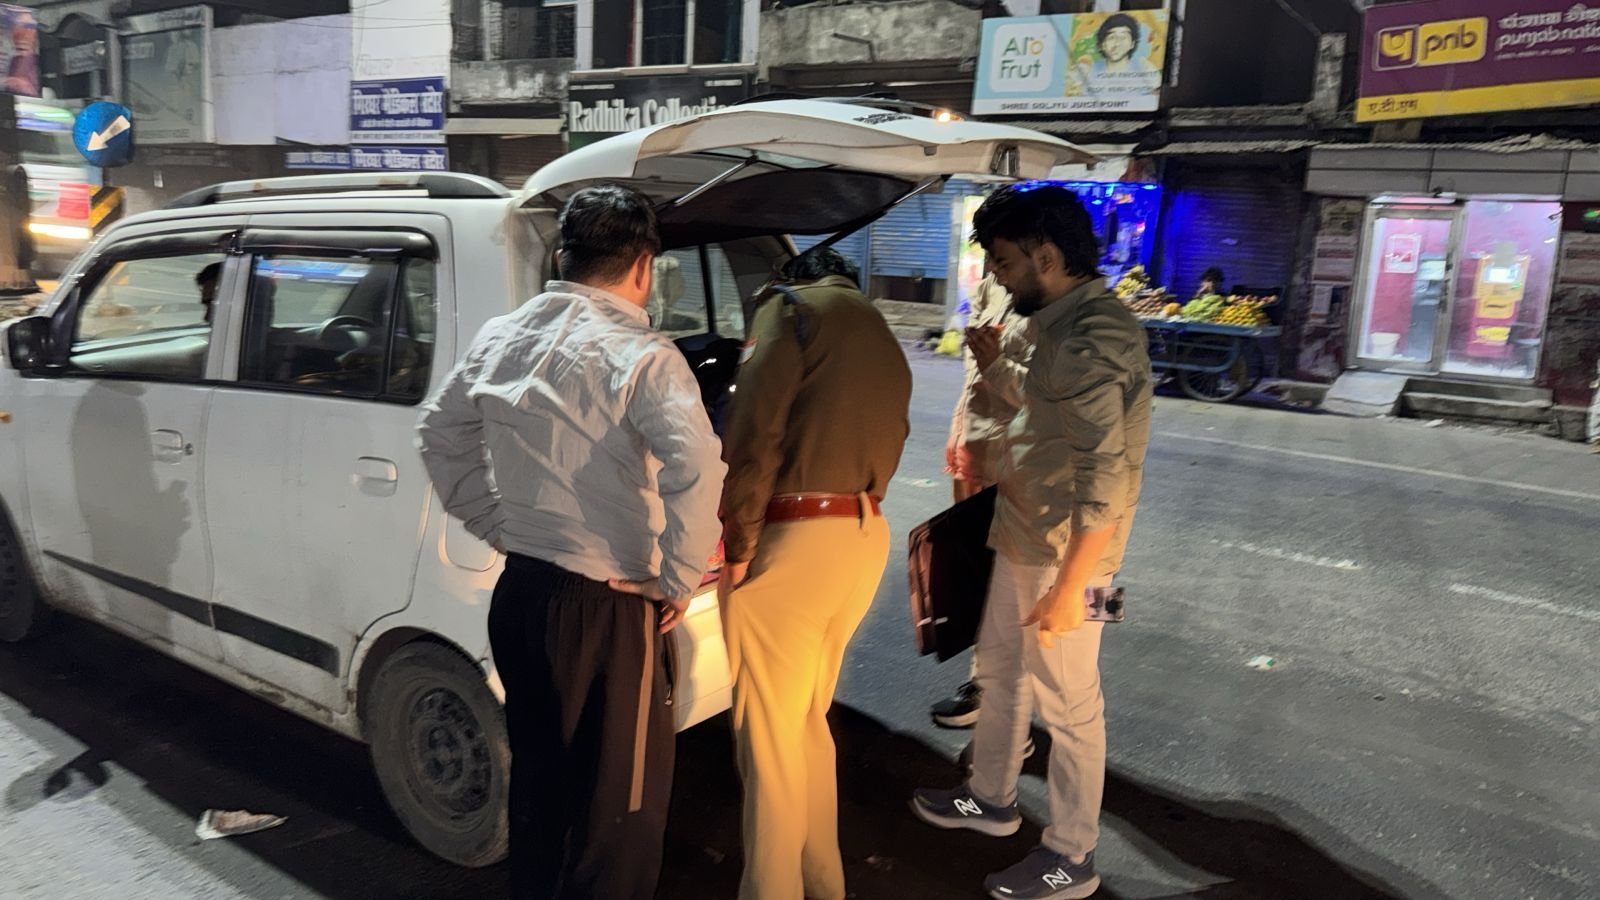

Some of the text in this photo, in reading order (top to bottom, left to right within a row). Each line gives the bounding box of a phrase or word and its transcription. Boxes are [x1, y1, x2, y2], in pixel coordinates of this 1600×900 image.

[1421, 24, 1478, 60] pnb
[1495, 26, 1561, 52] punjab
[1000, 59, 1042, 79] Frut
[569, 98, 640, 132] Radhika
[1099, 100, 1129, 108] POINT
